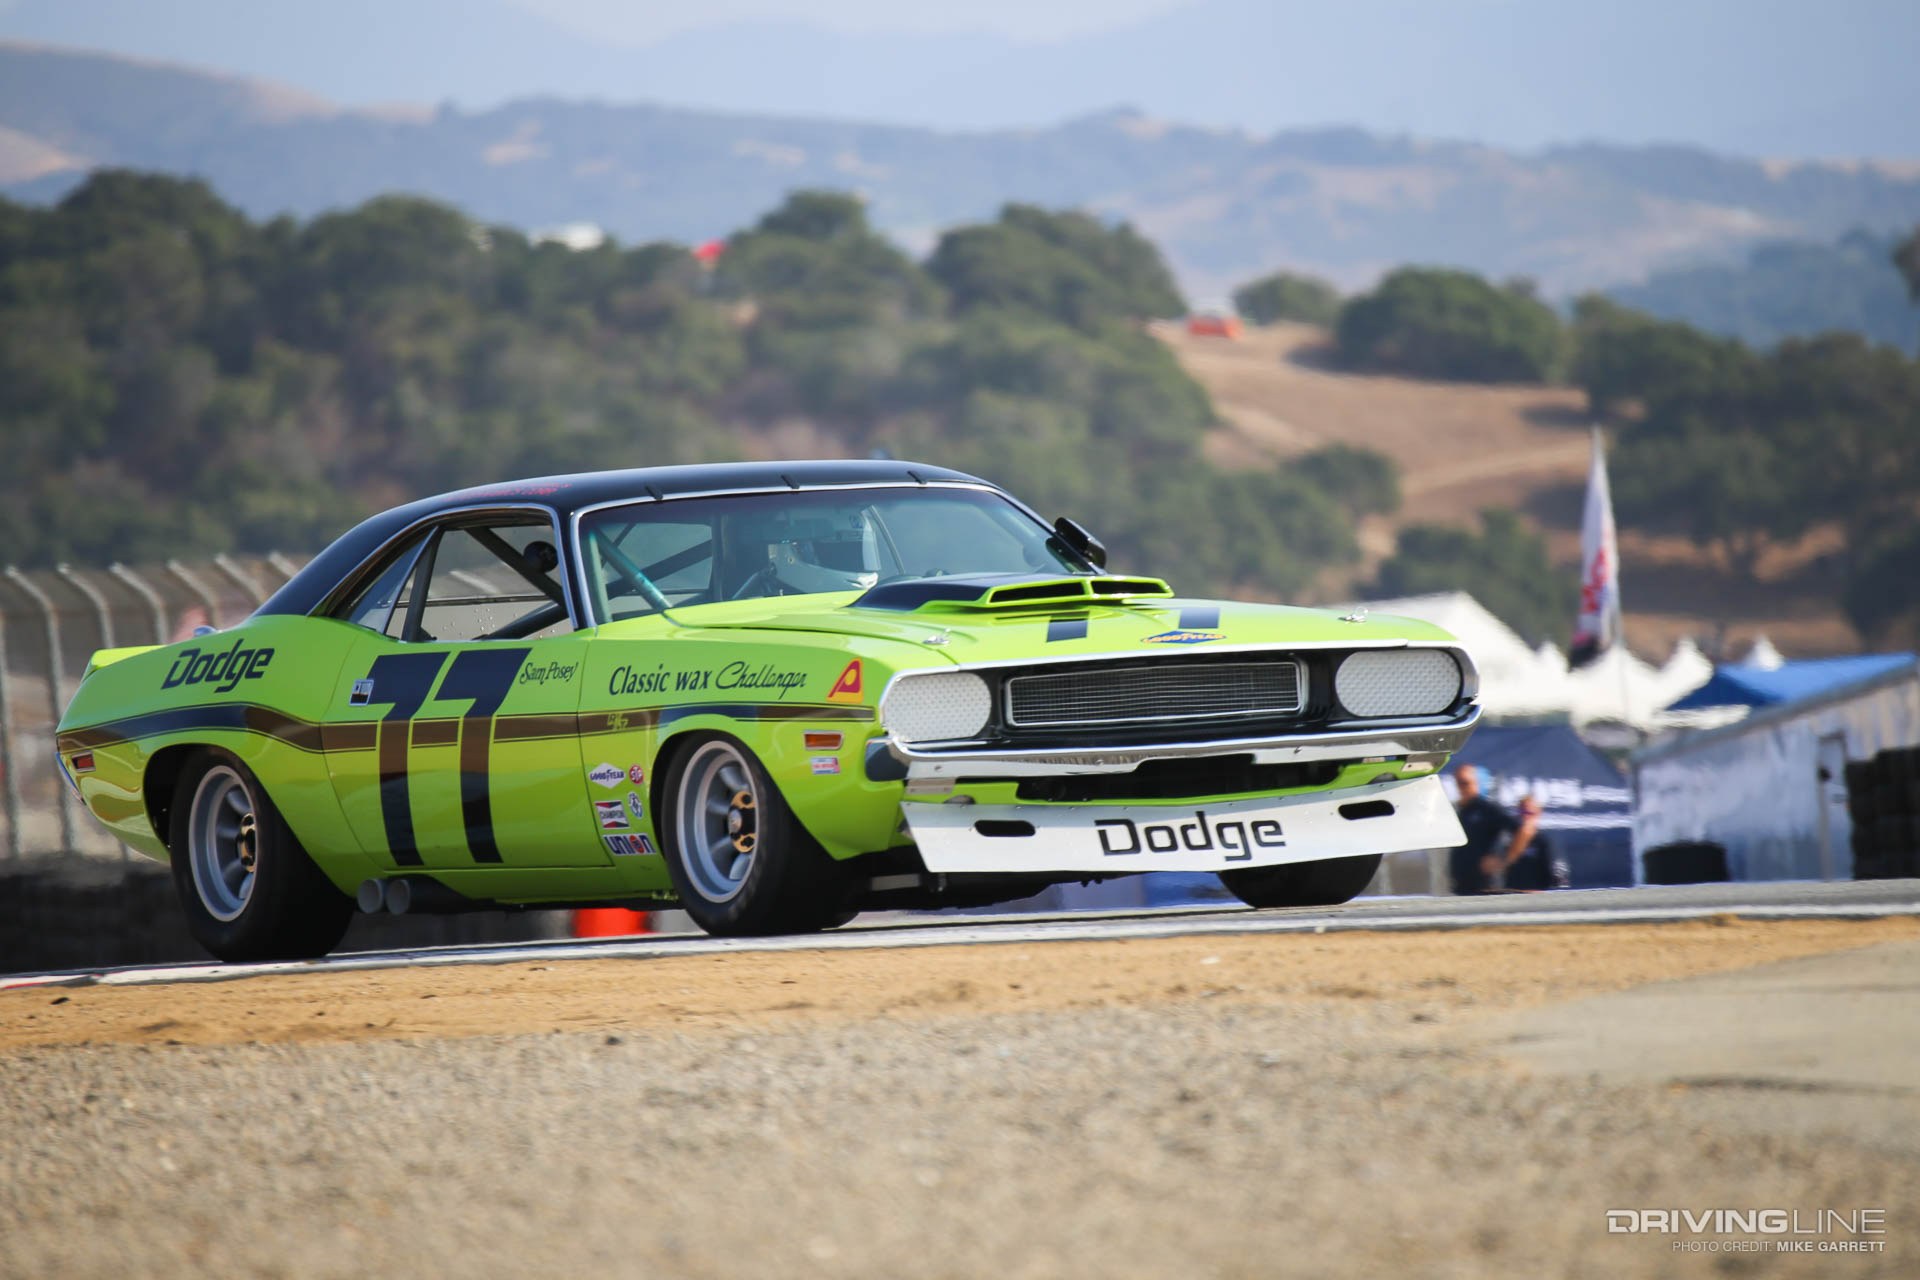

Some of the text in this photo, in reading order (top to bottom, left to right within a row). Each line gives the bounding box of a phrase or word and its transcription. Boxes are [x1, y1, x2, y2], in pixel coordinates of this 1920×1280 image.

[160, 638, 275, 693] Dodge
[519, 662, 546, 685] Sam
[609, 661, 808, 700] Classic wax Challenger
[362, 648, 533, 866] 77
[1094, 811, 1286, 861] Dodge
